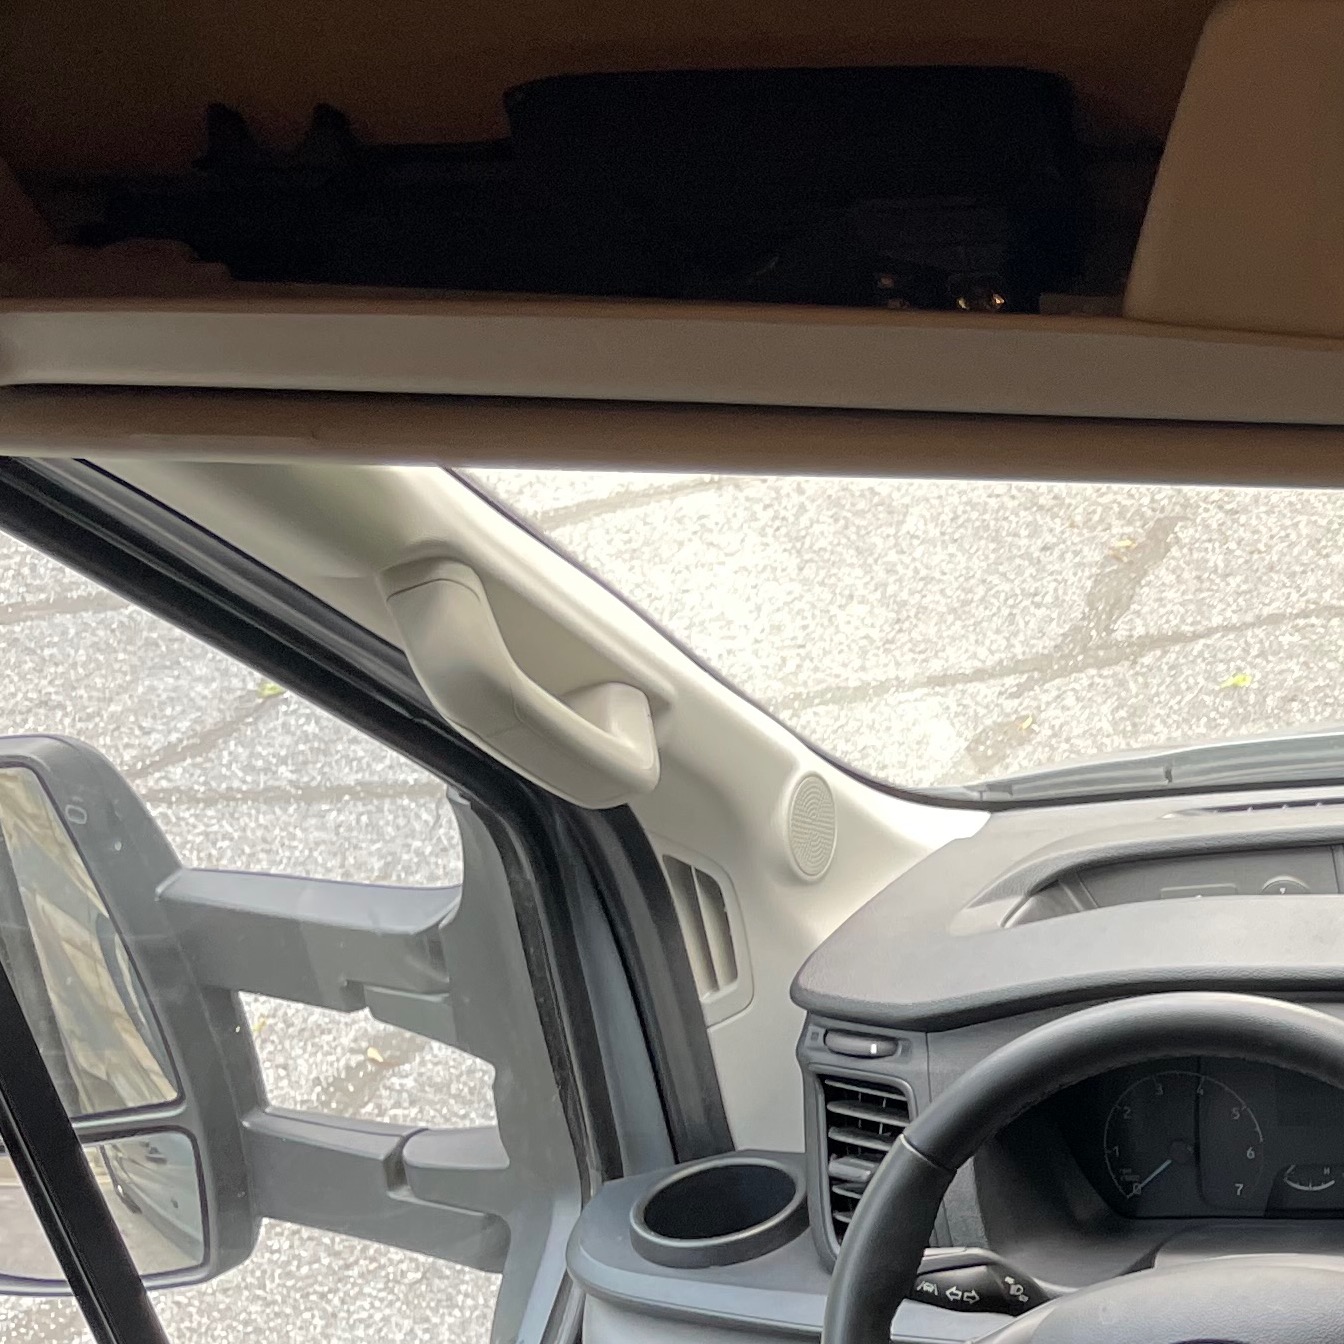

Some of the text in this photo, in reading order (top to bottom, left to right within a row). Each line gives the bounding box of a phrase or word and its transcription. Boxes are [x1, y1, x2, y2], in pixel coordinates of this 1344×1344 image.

[1123, 1106, 1131, 1119] 2
[1232, 1107, 1241, 1120] 5
[1246, 1147, 1255, 1159] 6
[1235, 1183, 1244, 1196] 7
